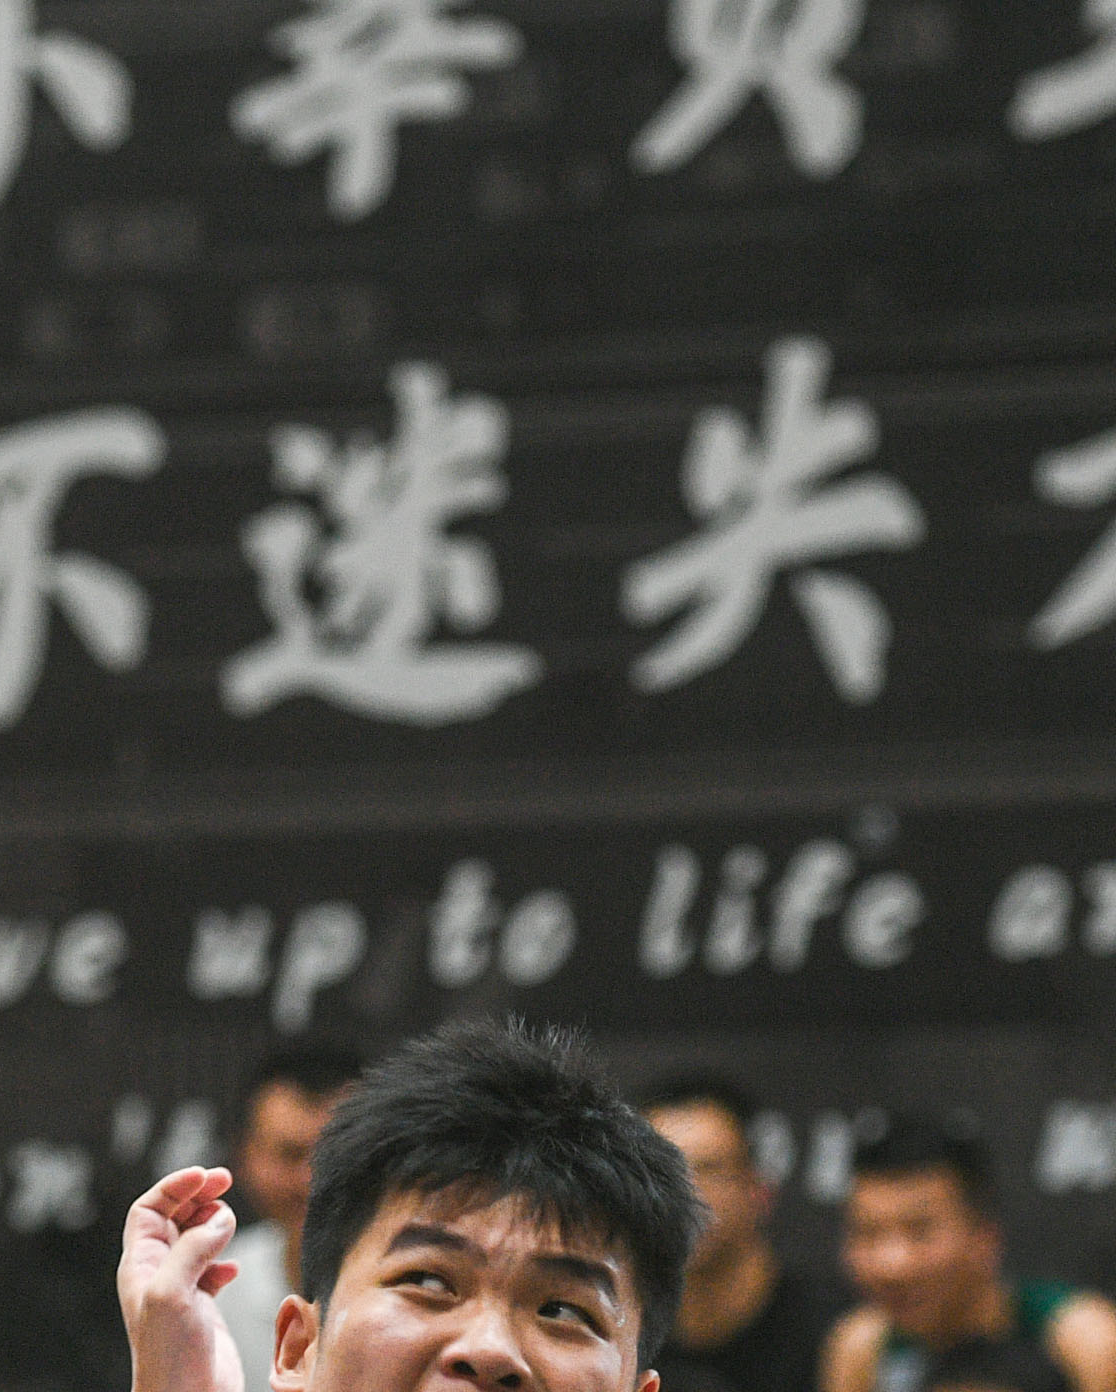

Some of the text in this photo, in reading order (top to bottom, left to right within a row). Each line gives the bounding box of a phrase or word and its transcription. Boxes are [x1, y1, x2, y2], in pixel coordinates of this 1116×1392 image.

[187, 900, 369, 1034] up
[427, 856, 577, 988] to
[638, 840, 926, 980] life
